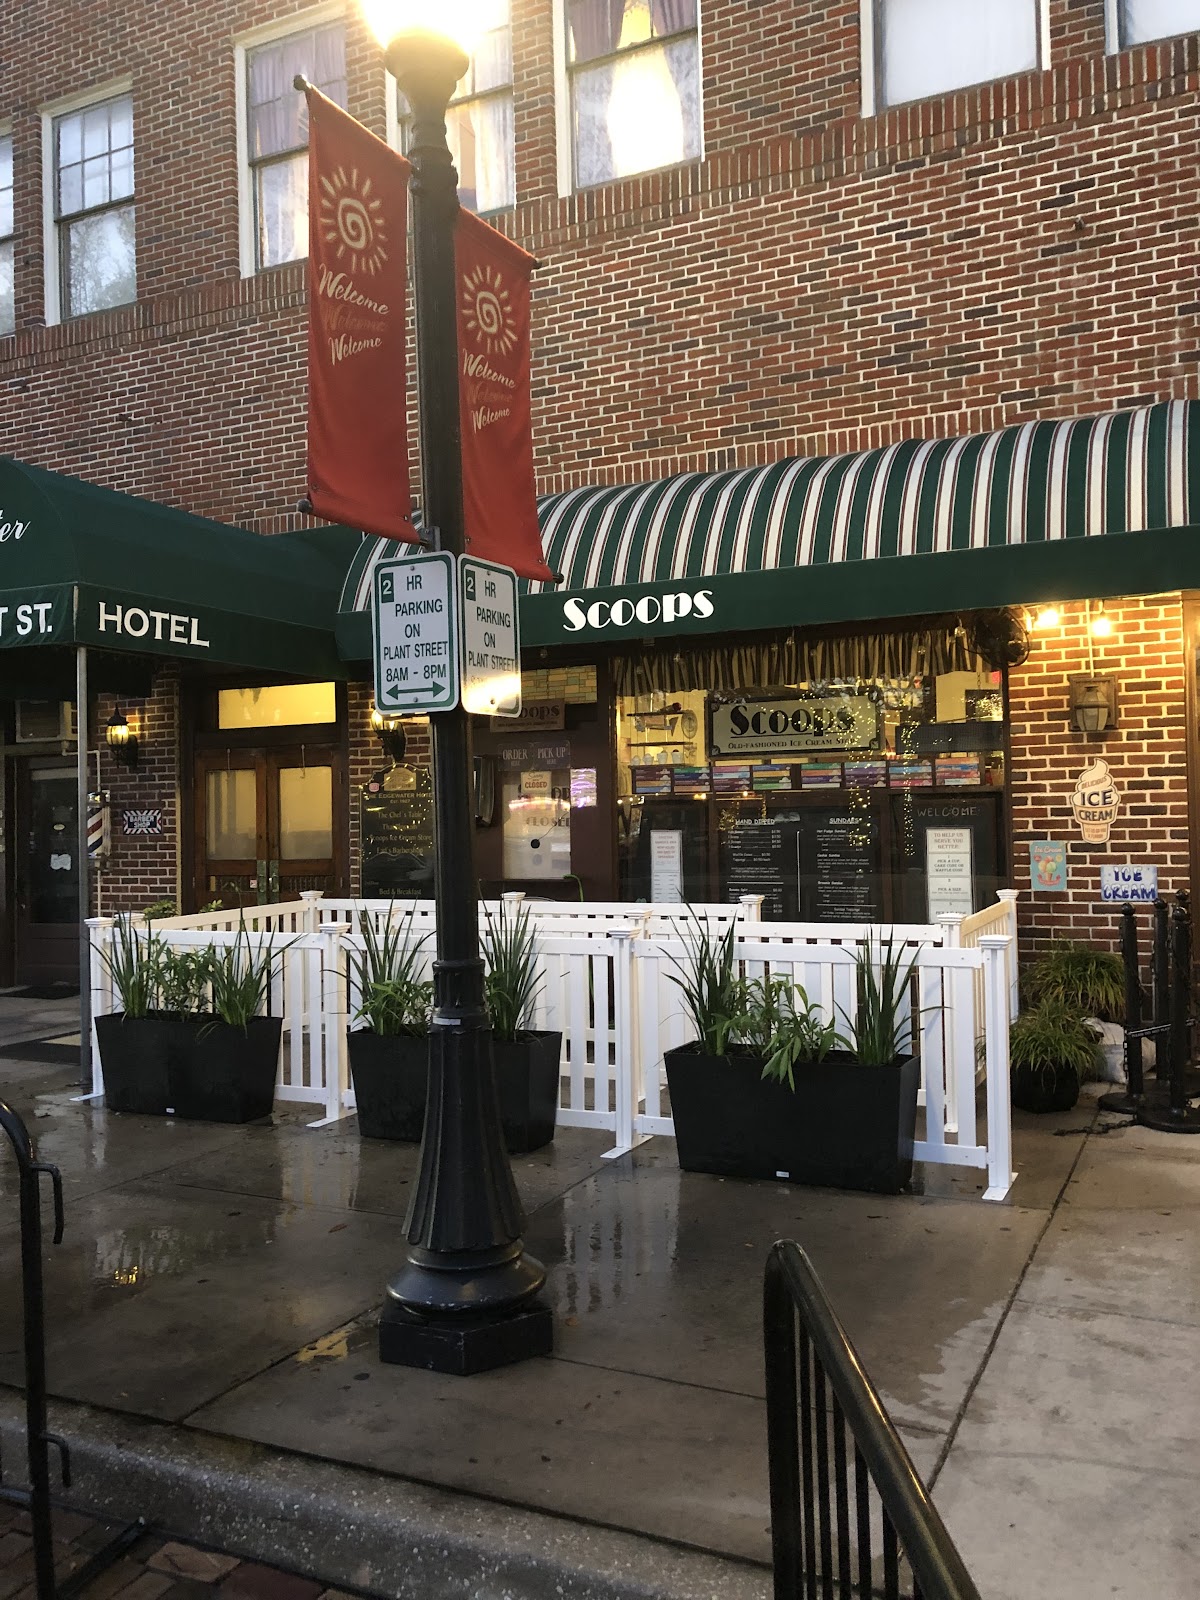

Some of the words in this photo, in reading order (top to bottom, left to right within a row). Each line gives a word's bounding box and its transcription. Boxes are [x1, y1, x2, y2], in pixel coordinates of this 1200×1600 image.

[319, 263, 390, 315] Welcome
[328, 333, 383, 366] Welcome
[462, 347, 516, 388] Welcome
[471, 405, 511, 434] Welcome
[0, 511, 31, 543] er
[382, 579, 392, 595] 2
[406, 574, 422, 591] HR
[466, 576, 474, 593] 2
[484, 580, 496, 598] HR
[395, 598, 443, 617] PARKING
[476, 606, 511, 628] PARKING
[16, 602, 53, 636] ST.
[98, 601, 210, 648] HOTEL
[404, 623, 421, 639] ON
[483, 631, 496, 648] ON
[383, 644, 410, 661] PLANT
[414, 641, 448, 658] STREET
[468, 650, 488, 669] PLANT
[491, 656, 515, 673] STREET
[386, 666, 409, 683] 8AM
[423, 663, 447, 680] 8PM
[502, 749, 528, 760] ORDER
[537, 747, 554, 759] PICK
[556, 746, 566, 758] UP
[524, 781, 548, 789] CLOSED
[1081, 775, 1108, 789] DELICIOUS
[1080, 789, 1114, 807] ICE
[917, 806, 978, 817] WELCOME
[1078, 808, 1113, 821] CREAM
[1113, 866, 1143, 882] ICE
[1103, 884, 1156, 900] CREAM
